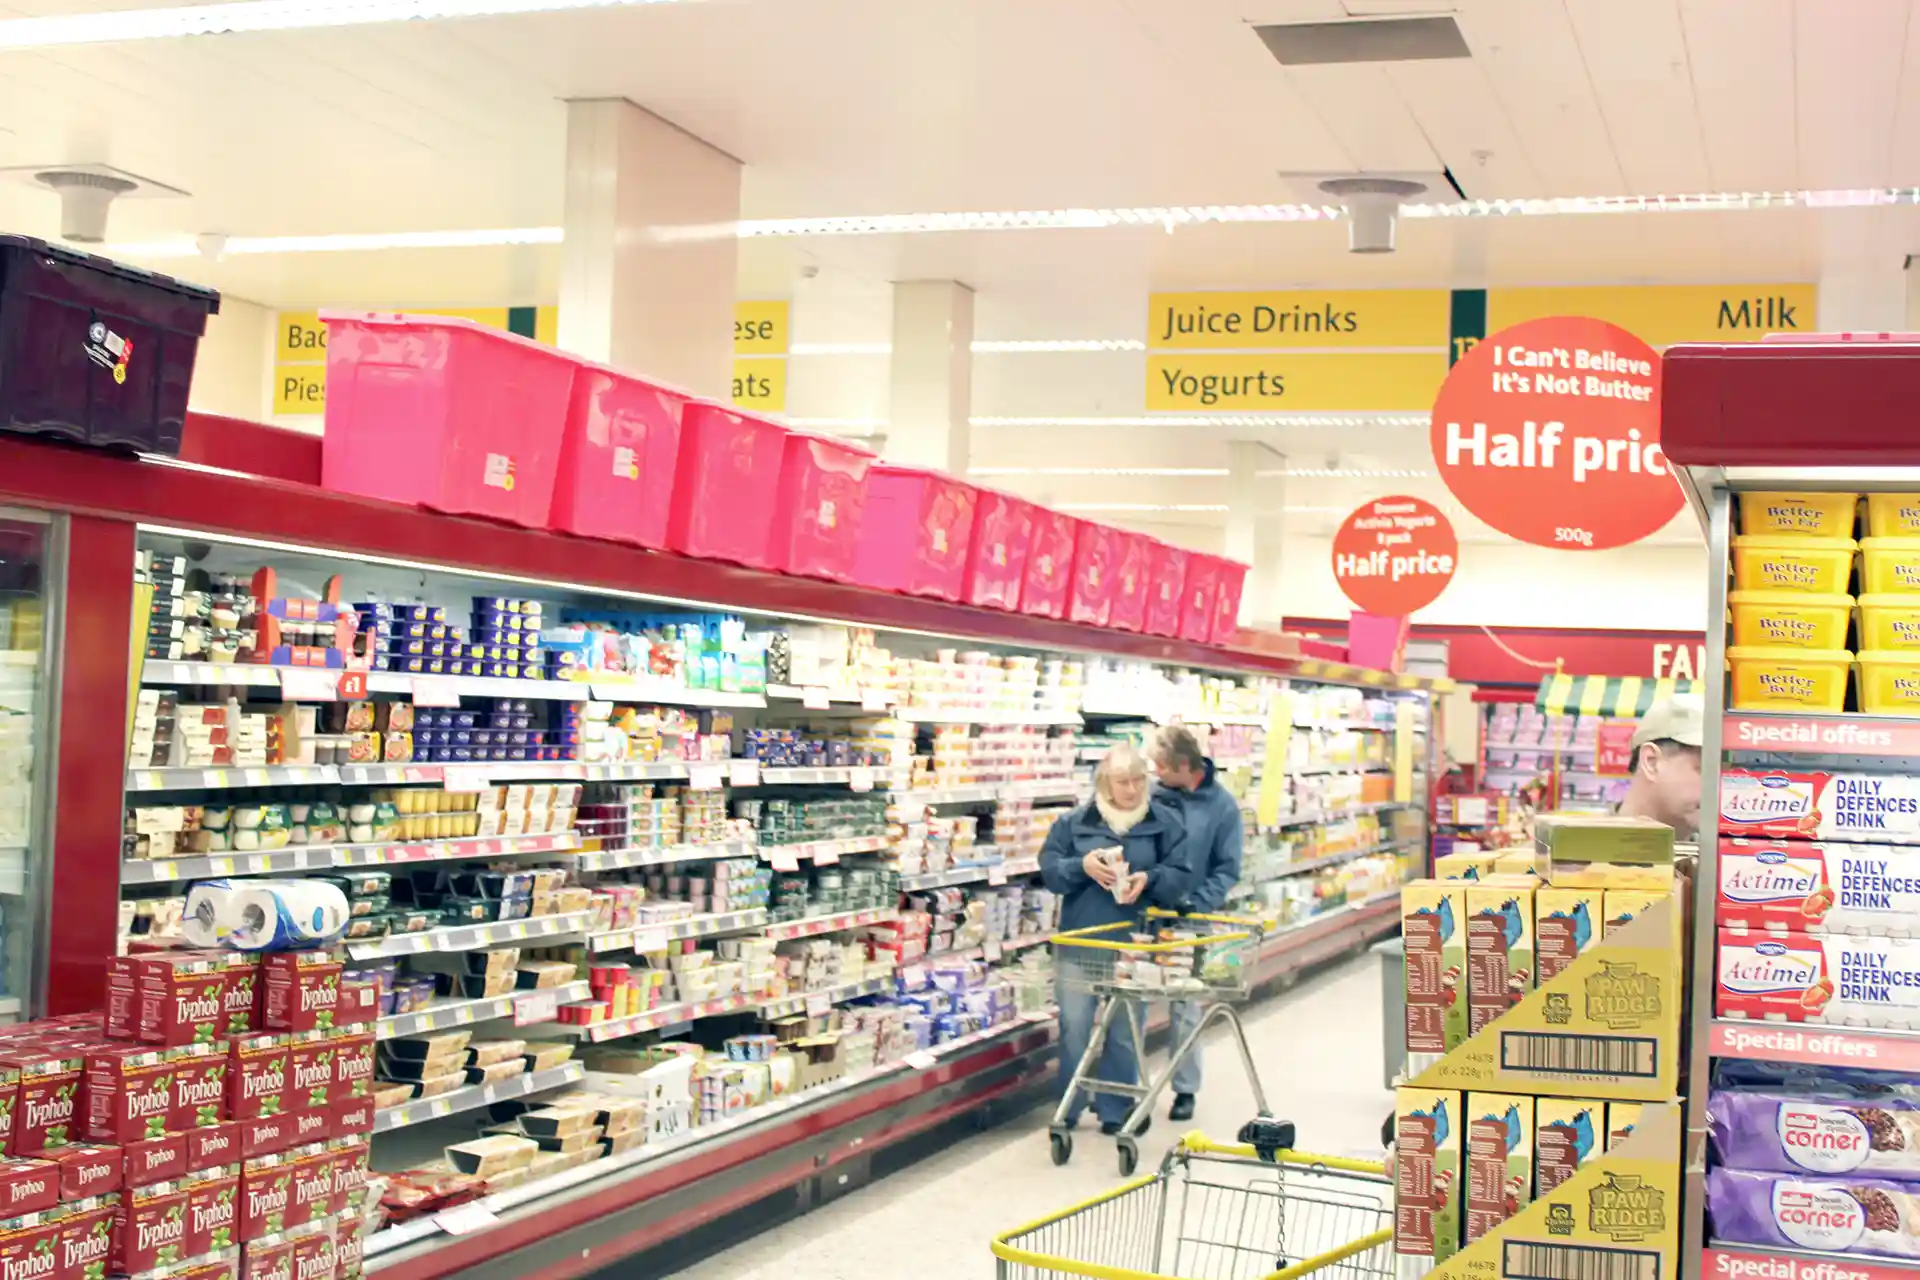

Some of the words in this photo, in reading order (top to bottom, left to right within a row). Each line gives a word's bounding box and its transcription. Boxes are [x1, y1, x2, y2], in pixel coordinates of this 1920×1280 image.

[1162, 306, 1241, 340] Juice
[1254, 303, 1358, 333] Drinks
[1717, 297, 1798, 329] Milk
[1493, 346, 1502, 366] I
[1508, 347, 1570, 369] Can't
[1575, 349, 1652, 376] Believe
[1161, 369, 1285, 405] Yogurts
[1492, 372, 1530, 393] It's
[1535, 374, 1581, 396] Not
[1585, 376, 1653, 402] Butter
[1446, 421, 1565, 468] Half
[1573, 428, 1672, 482] pric
[1767, 505, 1823, 520] Better
[1555, 527, 1594, 546] 500g
[1337, 549, 1390, 577] Half
[1392, 548, 1454, 582] price
[1763, 562, 1819, 576] Better
[1759, 617, 1816, 632] Better
[1759, 673, 1816, 688] Better
[1738, 721, 1817, 745] Special
[1824, 724, 1892, 746] offers
[1836, 779, 1881, 796] DAILY
[1725, 792, 1809, 813] Actimel
[1836, 796, 1917, 814] DEFENCES
[1835, 812, 1886, 829] DRINK
[1842, 859, 1888, 876] DAILY
[1726, 869, 1818, 891] Actimel
[1841, 876, 1920, 894] DEFENCES
[1841, 892, 1892, 909] DRINK
[1841, 951, 1888, 968] DAILY
[1725, 961, 1817, 984] Actimel
[1840, 968, 1920, 987] DEFENCES
[1599, 977, 1645, 996] PAW
[1840, 984, 1892, 1002] DRINK
[176, 995, 219, 1024] Typhoo
[224, 987, 253, 1012] phoo
[300, 985, 338, 1012] Typhoo
[1589, 996, 1660, 1014] RIDGE
[1723, 1029, 1802, 1052] Special
[1808, 1036, 1878, 1058] offers
[294, 1062, 331, 1090] Typhoo
[338, 1053, 373, 1081] Typhoo
[176, 1078, 223, 1107] Typhoo
[242, 1068, 284, 1098] Typhoo
[25, 1096, 73, 1130] Typhoo
[126, 1088, 170, 1119] Typhoo
[253, 1125, 280, 1145] Typhoo
[298, 1114, 323, 1134] Typhoo
[200, 1134, 229, 1156] Typhoo
[1785, 1130, 1862, 1151] corner
[145, 1149, 176, 1170] Typhoo
[78, 1163, 111, 1185] Typhoo
[10, 1180, 45, 1203] Typhoo
[296, 1175, 332, 1205] Typhoo
[1603, 1191, 1650, 1209] PAW
[248, 1188, 287, 1219] Typhoo
[191, 1201, 233, 1233] Typhoo
[1592, 1208, 1664, 1226] RIDGE
[1779, 1209, 1857, 1229] corner
[136, 1218, 184, 1251] Typhoo
[62, 1234, 110, 1268] Typhoo
[1, 1252, 55, 1280] Typhoo
[296, 1252, 333, 1280] Typhoo
[1716, 1254, 1796, 1278] Special
[1801, 1262, 1870, 1280] offers
